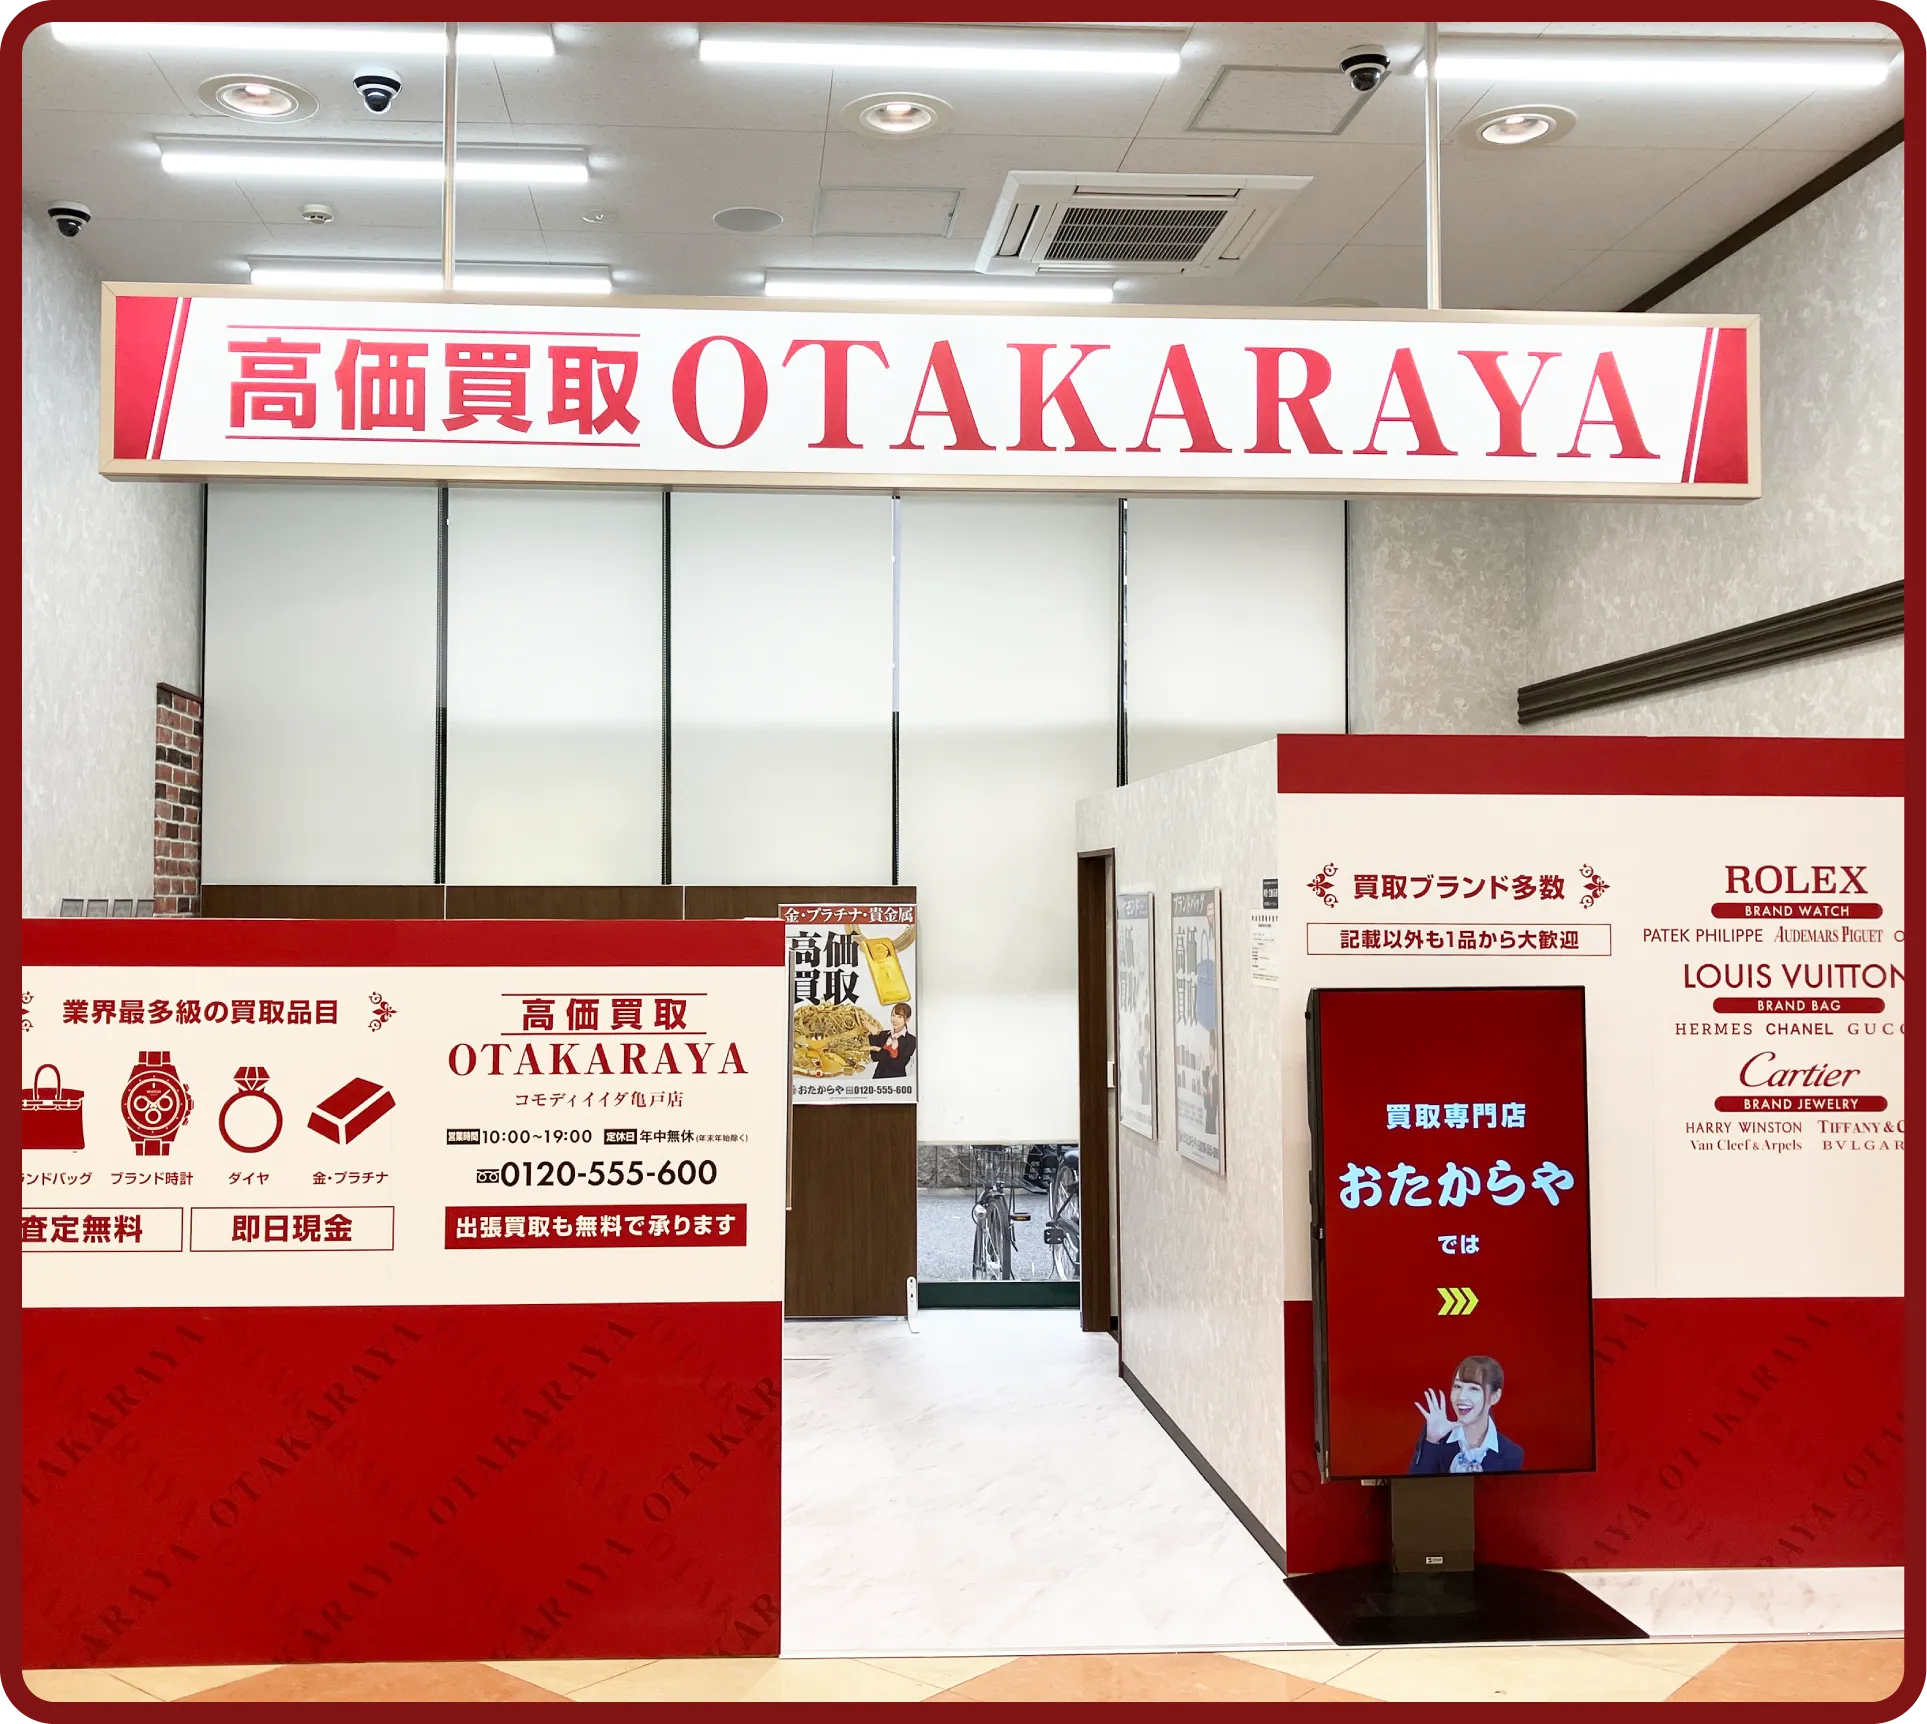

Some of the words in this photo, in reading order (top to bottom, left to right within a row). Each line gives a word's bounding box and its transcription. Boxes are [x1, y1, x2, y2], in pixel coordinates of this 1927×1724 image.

[228, 336, 640, 434] 高価買取
[672, 336, 1660, 459] OTAKARAYA
[1354, 874, 1564, 900] 買取ブランド多数
[1725, 865, 1868, 894] ROLEX
[784, 907, 914, 923] 金・プラチナ・貴金属
[1746, 906, 1792, 916] BRAND
[1799, 906, 1849, 916] WATCH
[1340, 930, 1579, 949] 記載以外も1品から大歓迎
[1644, 929, 1689, 942] PATEK
[1697, 929, 1762, 942] PHILIPPE
[1774, 926, 1838, 942] AUDEMARS
[1842, 926, 1883, 942] PIGUET
[786, 930, 860, 968] 高価
[1685, 964, 1771, 988] LOUIS
[1782, 964, 1904, 988] VUITTON
[63, 1000, 337, 1024] 業界最多級の買取品目
[522, 998, 686, 1030] 高価買取
[1758, 1000, 1805, 1011] BRAND
[1812, 1000, 1840, 1011] BAG
[1676, 1023, 1752, 1035] HERMES
[1766, 1023, 1833, 1035] CHANEL
[449, 1043, 748, 1076] OTAKARAYA
[1740, 1052, 1860, 1087] Cartier
[516, 1091, 683, 1107] コモディイイダ亀戸店
[798, 1085, 844, 1095] おたからや
[854, 1086, 912, 1094] 0120-555-600
[1744, 1099, 1792, 1109] BRAND
[1798, 1098, 1858, 1109] JEWELRY
[1387, 1102, 1525, 1129] 買取専門店
[448, 1131, 478, 1141] 営業時間
[606, 1132, 634, 1142] 定休日
[1686, 1122, 1731, 1133] HARRY
[1739, 1122, 1801, 1133] WINSTON
[1691, 1141, 1712, 1150] Van
[1718, 1140, 1750, 1150] Cleef
[1753, 1142, 1761, 1150] &
[1765, 1140, 1801, 1153] Arpels
[22, 1172, 92, 1185] ンドバッグ
[111, 1172, 193, 1185] ブランド時計
[229, 1172, 269, 1184] ダイヤ
[313, 1171, 388, 1184] 金・プラチナ
[501, 1160, 717, 1187] 0120-555-600
[1339, 1160, 1574, 1209] おたからや
[22, 1215, 142, 1243] 査定無料
[232, 1214, 352, 1242] 即日現金
[457, 1214, 735, 1238] 出張買取も無料で承ります
[1438, 1235, 1479, 1254] では
[208, 1320, 425, 1530] OTAKARAYA
[427, 1317, 638, 1528] OTAKARAYA
